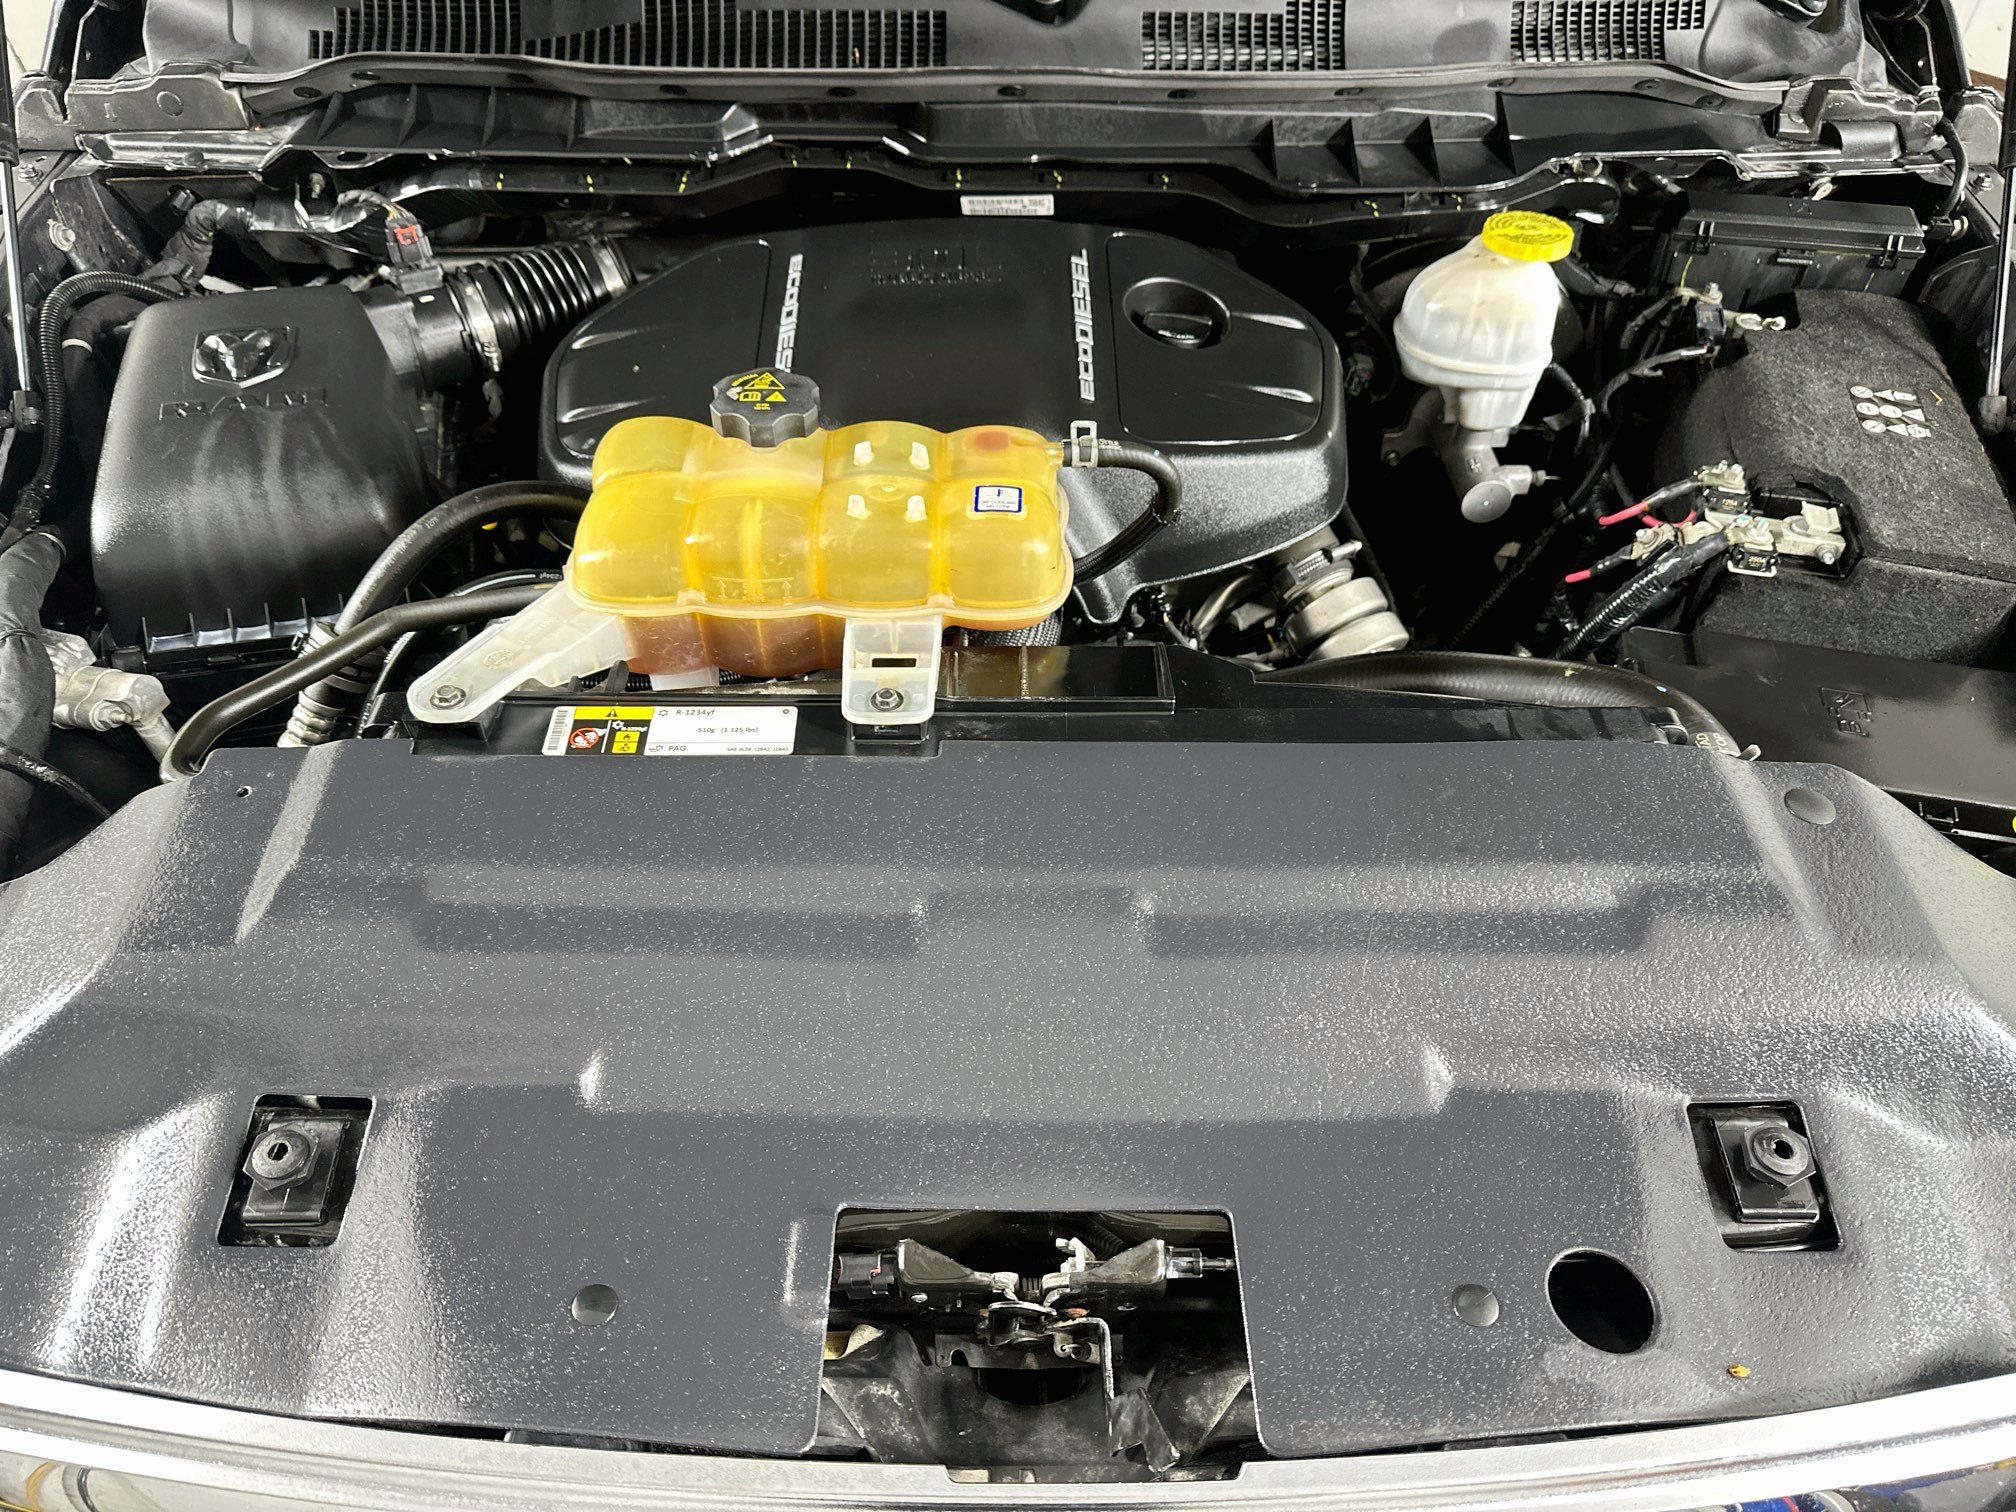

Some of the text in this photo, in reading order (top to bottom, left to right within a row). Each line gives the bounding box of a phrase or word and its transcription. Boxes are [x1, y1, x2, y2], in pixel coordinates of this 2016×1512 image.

[775, 253, 803, 373] ECODIES
[1070, 248, 1096, 402] ECODIESEL
[159, 388, 329, 421] RAM
[675, 708, 716, 716] R-1234yf
